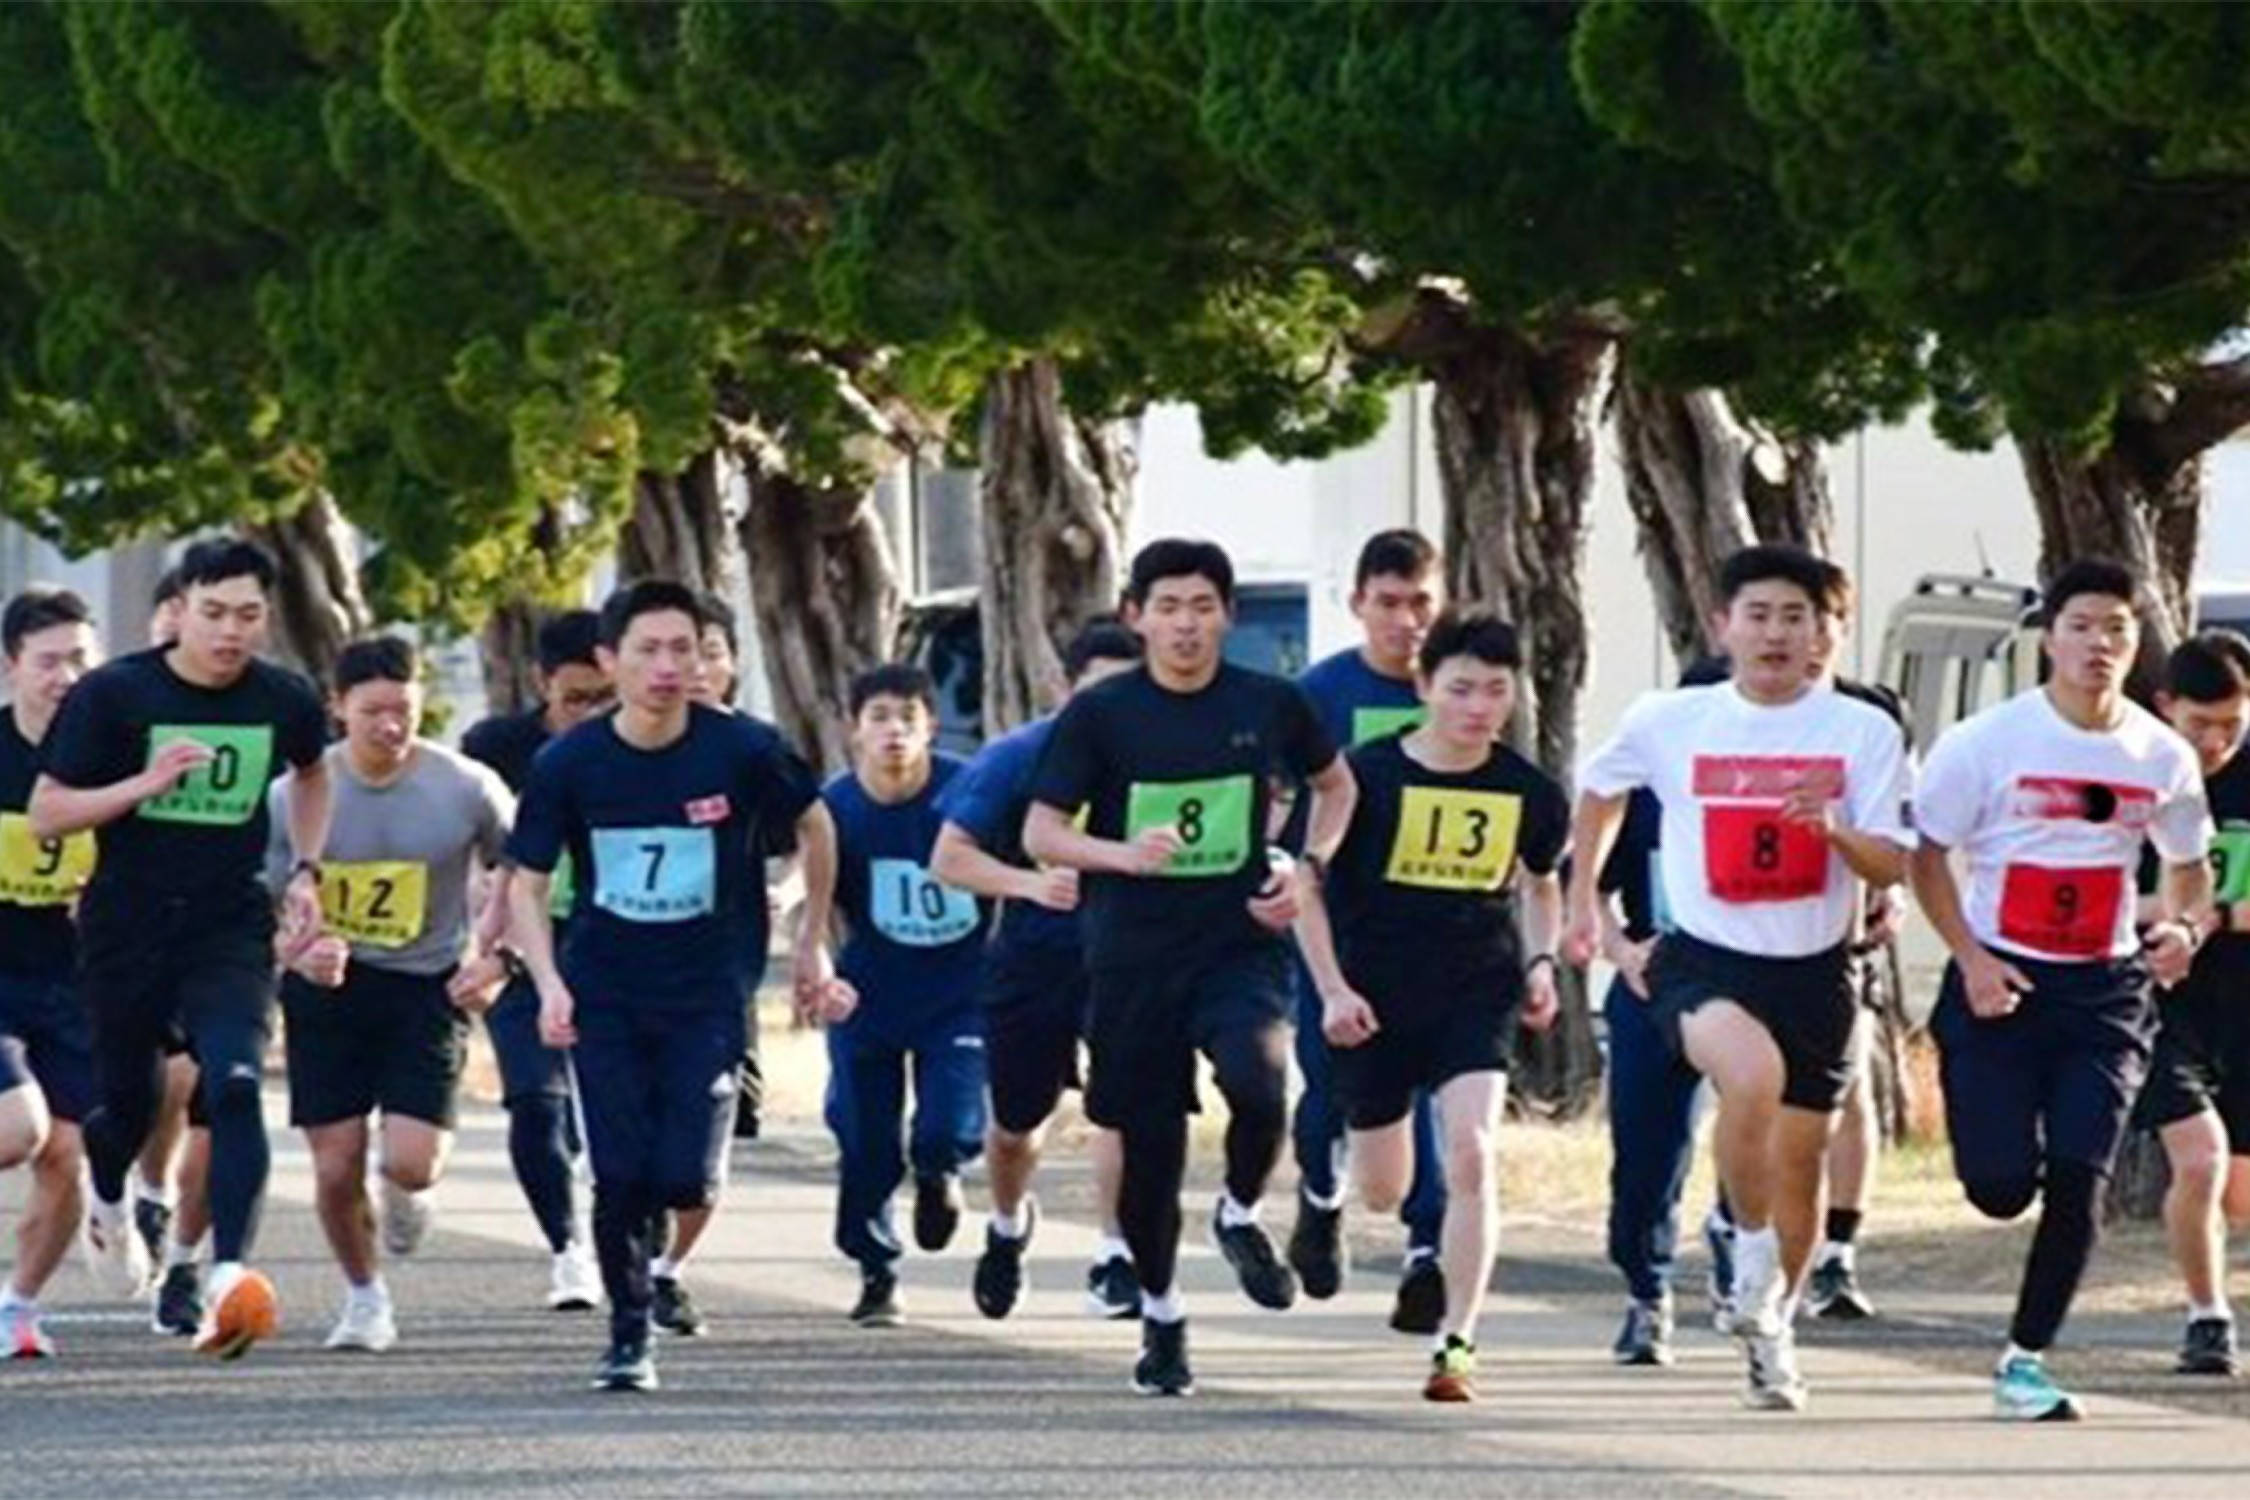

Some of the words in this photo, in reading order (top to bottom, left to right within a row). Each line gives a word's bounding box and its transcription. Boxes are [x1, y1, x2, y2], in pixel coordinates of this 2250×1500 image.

[1177, 797, 1205, 846] 8
[1426, 804, 1490, 859] 13
[33, 834, 63, 877] 9
[638, 843, 666, 892] 7
[1752, 822, 1782, 873] 8
[338, 877, 395, 919] 12
[898, 873, 947, 922] 10
[2054, 883, 2079, 928] 9
